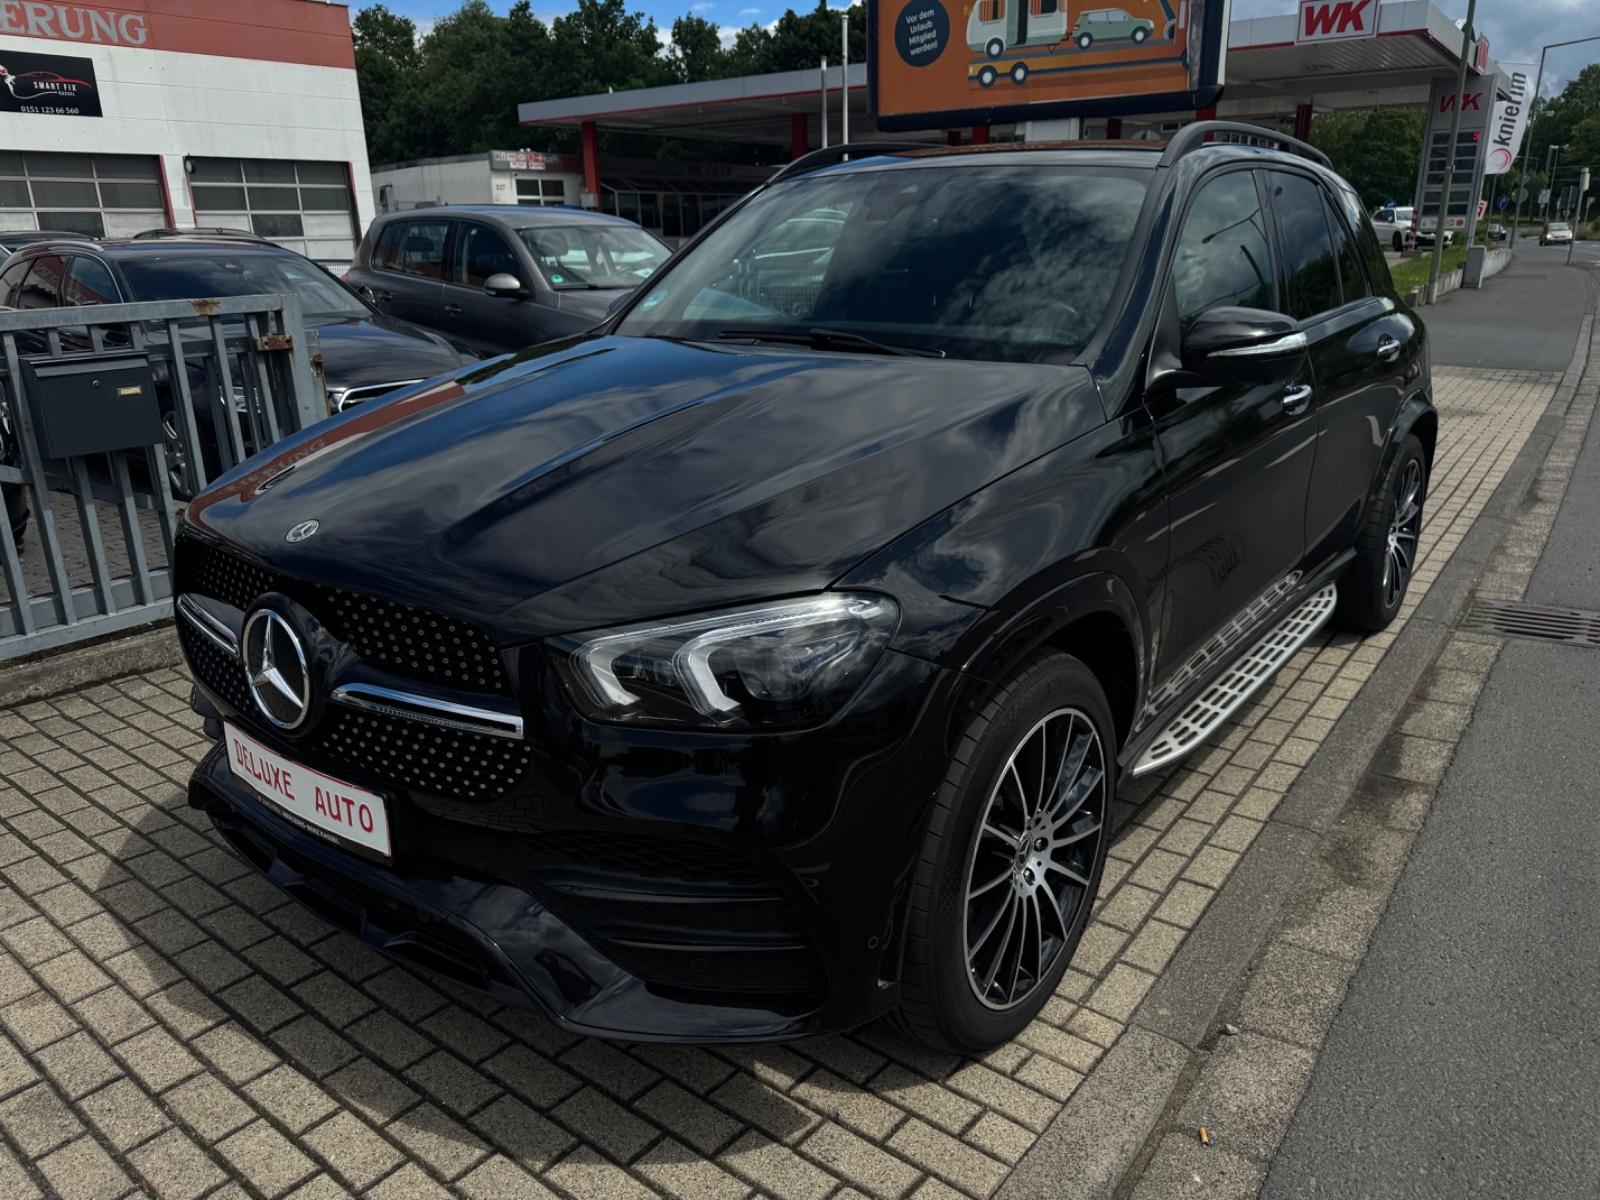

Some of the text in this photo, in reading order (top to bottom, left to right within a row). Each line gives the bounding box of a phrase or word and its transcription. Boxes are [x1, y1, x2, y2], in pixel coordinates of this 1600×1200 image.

[0, 0, 148, 45] ERUNG
[905, 9, 935, 24] Vor dem
[1305, 0, 1373, 36] WK
[910, 20, 933, 34] Urlaub
[909, 29, 937, 46] Mitglied
[910, 40, 938, 56] werden!
[33, 81, 77, 91] SMART FIX
[20, 105, 39, 113] 0151
[55, 106, 65, 114] 66
[233, 738, 374, 833] DELUXE AUTO
